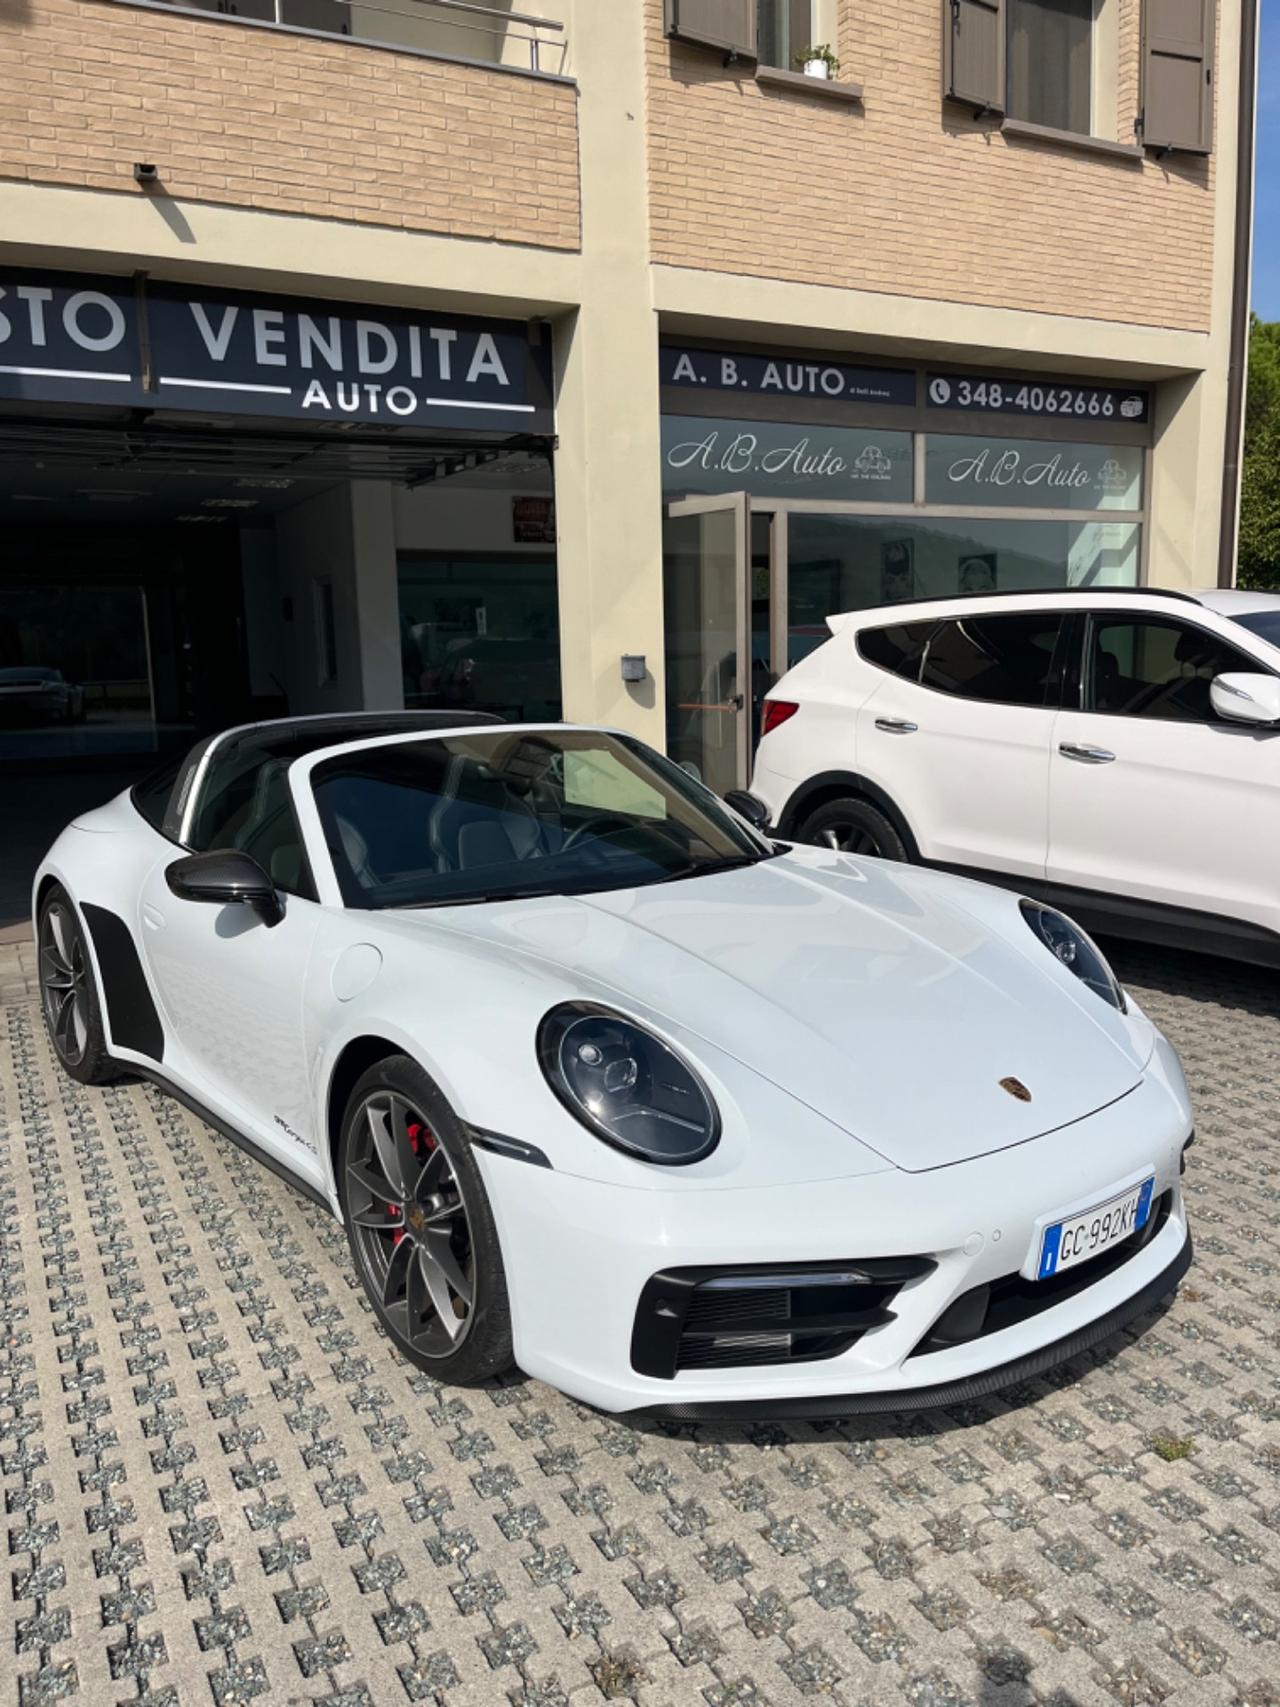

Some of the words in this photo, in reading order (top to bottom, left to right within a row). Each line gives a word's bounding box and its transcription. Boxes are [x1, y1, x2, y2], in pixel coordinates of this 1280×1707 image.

[189, 302, 510, 385] VENDITA
[760, 362, 845, 395] AUTO
[301, 380, 418, 416] AUTO
[957, 381, 1114, 416] 348-4062666
